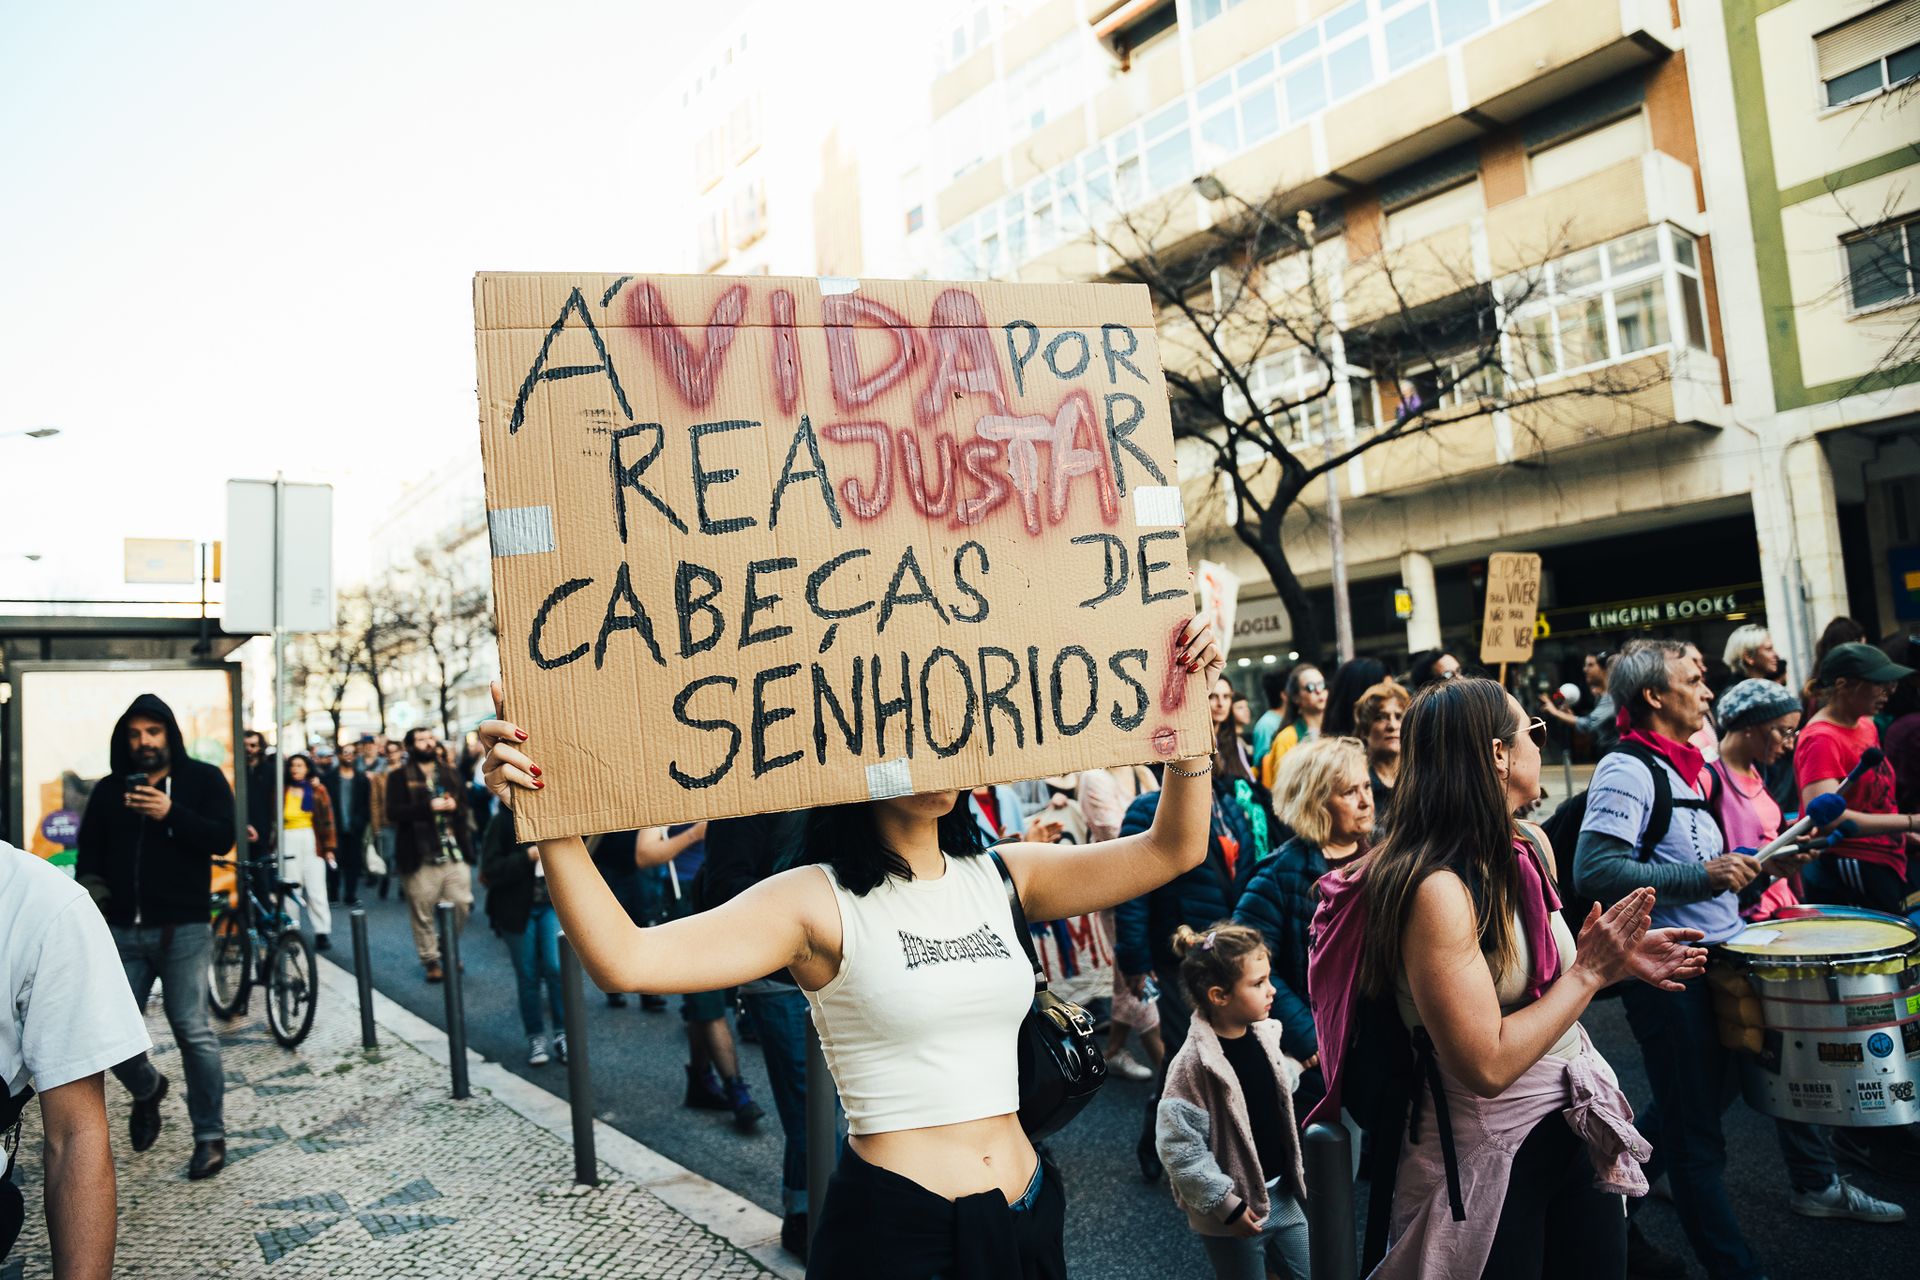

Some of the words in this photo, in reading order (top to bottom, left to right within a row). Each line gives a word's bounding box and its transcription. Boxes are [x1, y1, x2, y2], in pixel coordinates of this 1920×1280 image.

[624, 280, 1008, 426] VIDA
[1002, 319, 1151, 397] POR
[529, 540, 991, 671] CABEÇAS
[1071, 530, 1189, 609] DE
[1589, 604, 1660, 629] KINGPIN
[1666, 593, 1737, 620] BOOKS
[1858, 1082, 1883, 1091] MAKE
[1859, 1091, 1884, 1100] LOVE
